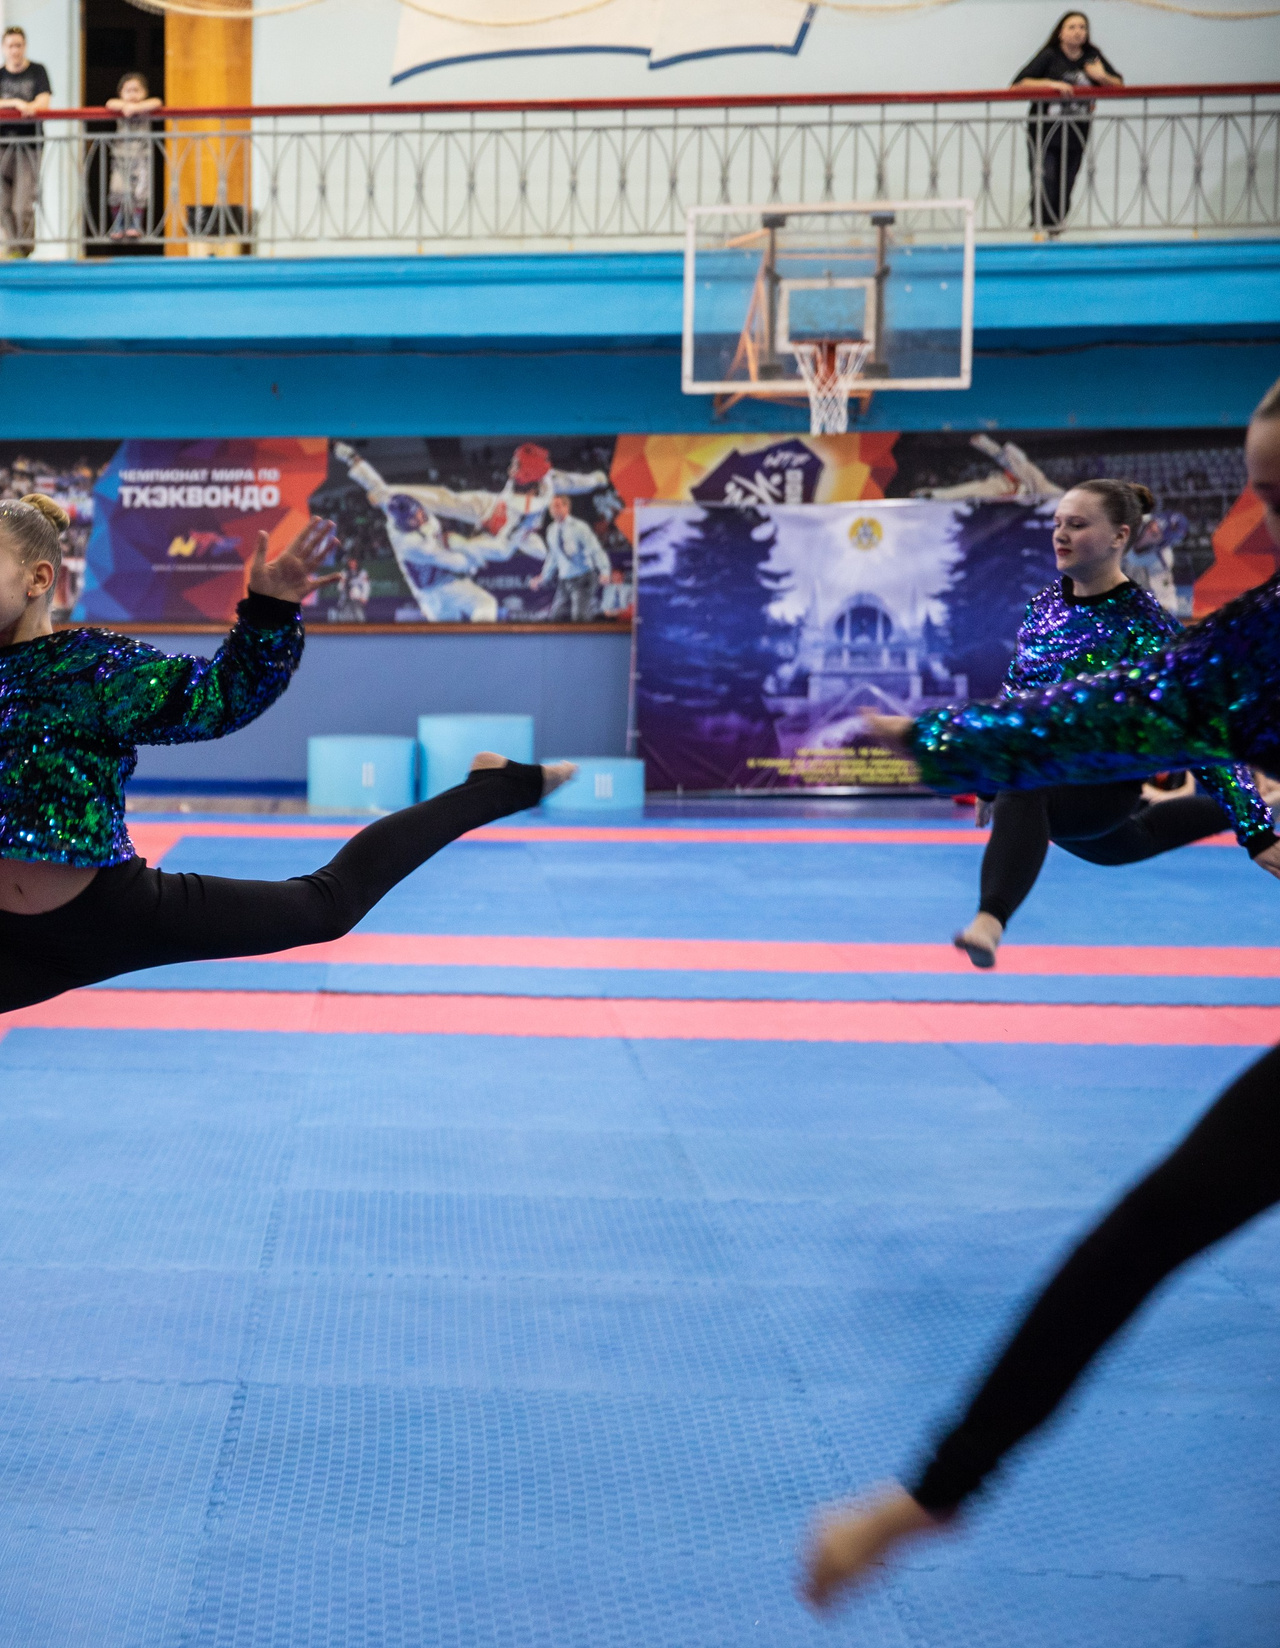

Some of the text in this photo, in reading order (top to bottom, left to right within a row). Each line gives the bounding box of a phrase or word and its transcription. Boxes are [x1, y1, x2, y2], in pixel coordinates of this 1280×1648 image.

[119, 469, 280, 482] ЧЕМПИОНАТ МИРА ПО
[119, 484, 281, 512] ТХЭКВОНДО
